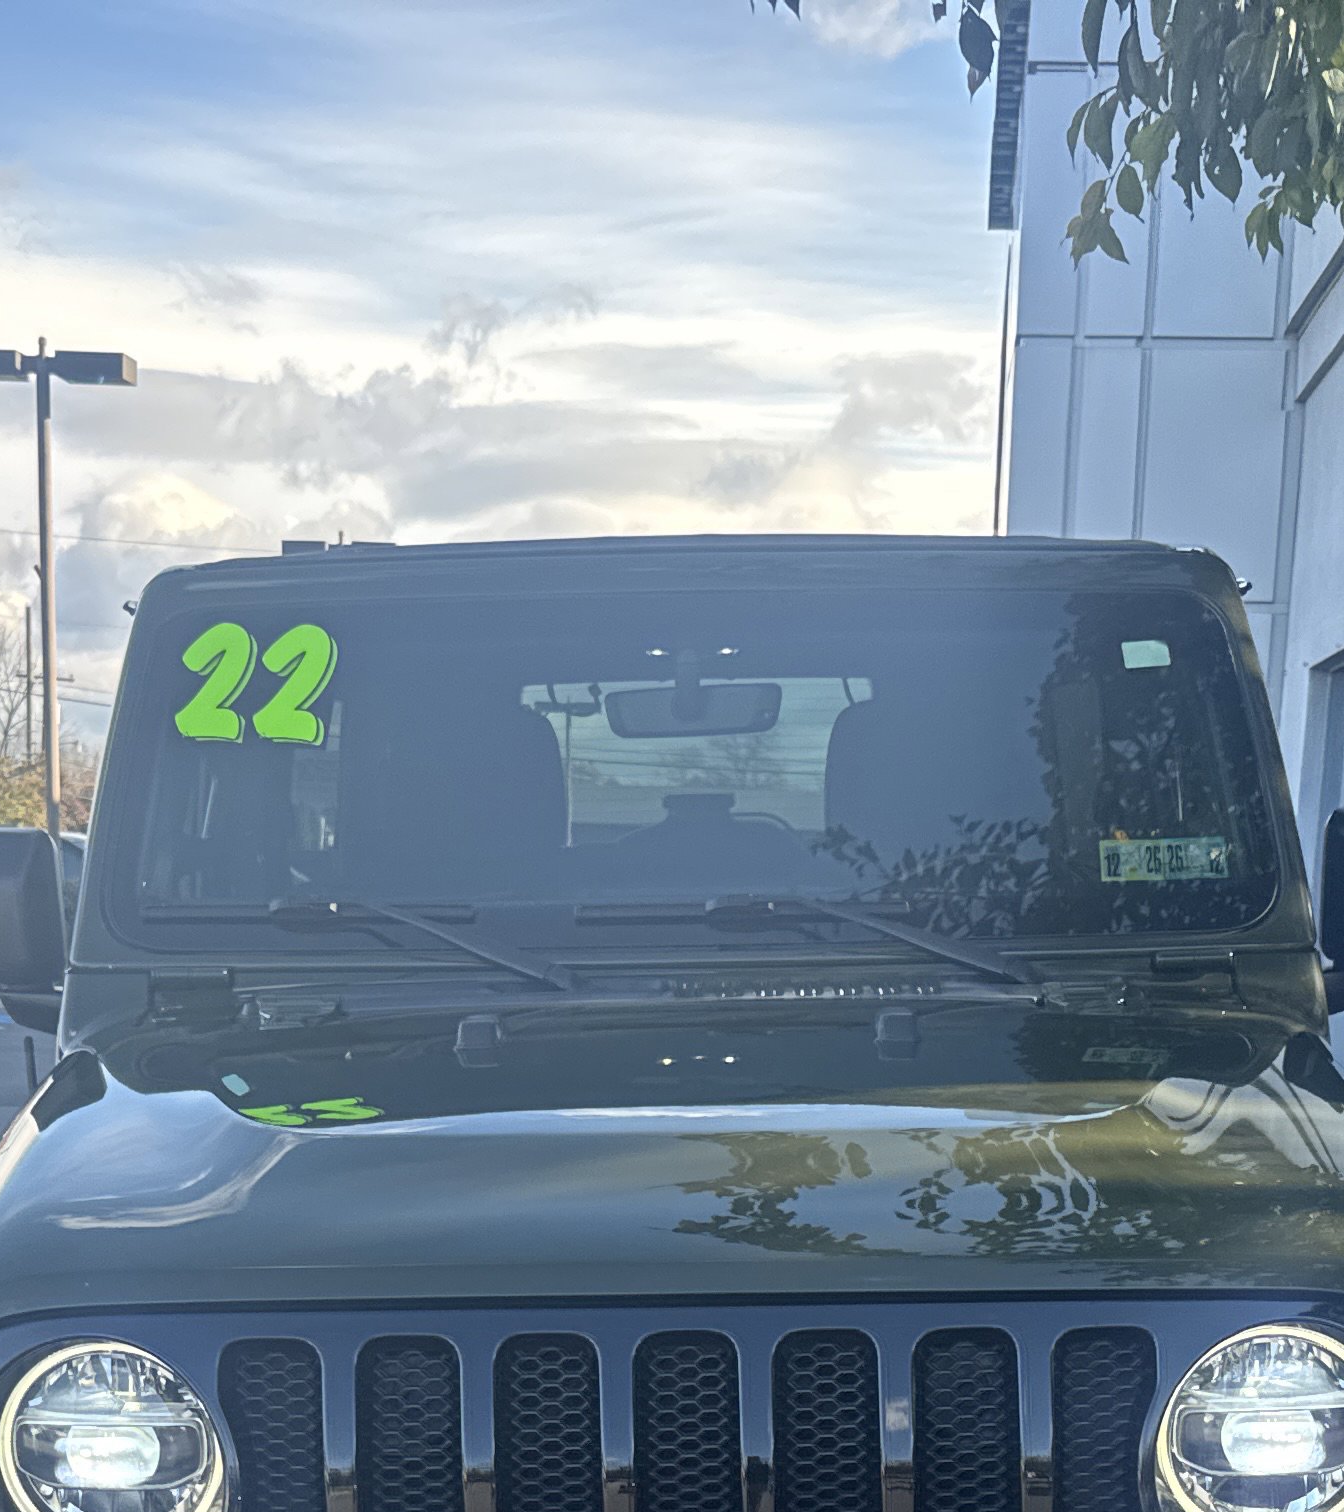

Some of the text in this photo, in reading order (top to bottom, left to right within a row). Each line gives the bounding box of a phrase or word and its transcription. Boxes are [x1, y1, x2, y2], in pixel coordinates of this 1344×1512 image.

[174, 622, 338, 746] 22
[1104, 852, 1121, 877] 12
[1166, 844, 1184, 873] 26
